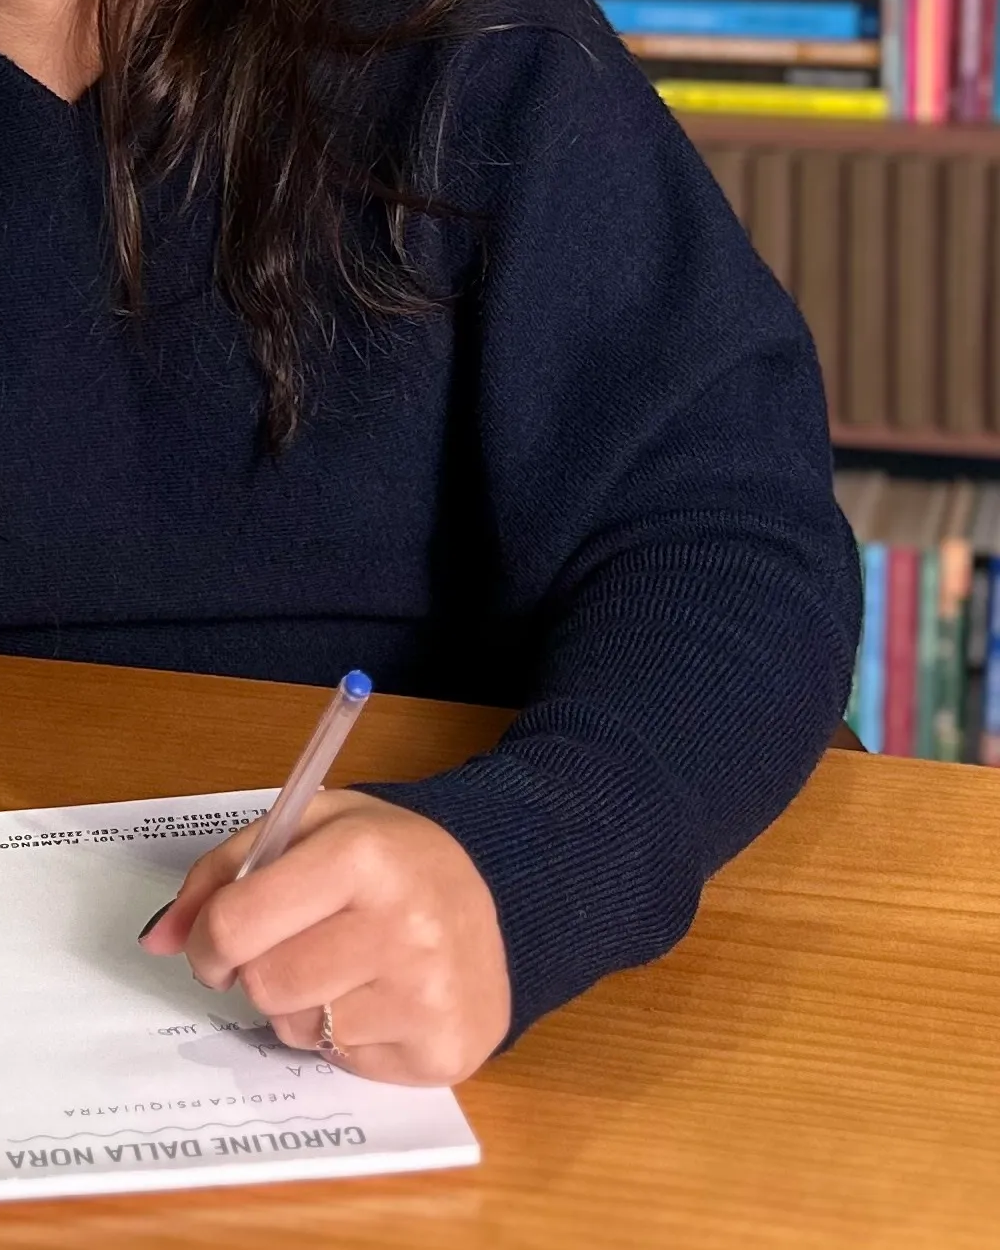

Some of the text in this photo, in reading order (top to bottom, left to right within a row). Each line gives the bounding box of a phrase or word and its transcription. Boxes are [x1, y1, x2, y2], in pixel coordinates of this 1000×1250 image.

[165, 819, 229, 830] JANEIRO
[8, 830, 83, 841] 22220-001
[172, 828, 225, 837] CATETE
[0, 838, 79, 849] FLAMENGO
[64, 1099, 202, 1117] PSIQUIATRA
[6, 1125, 367, 1169] CAROLINE DALLA NORA
